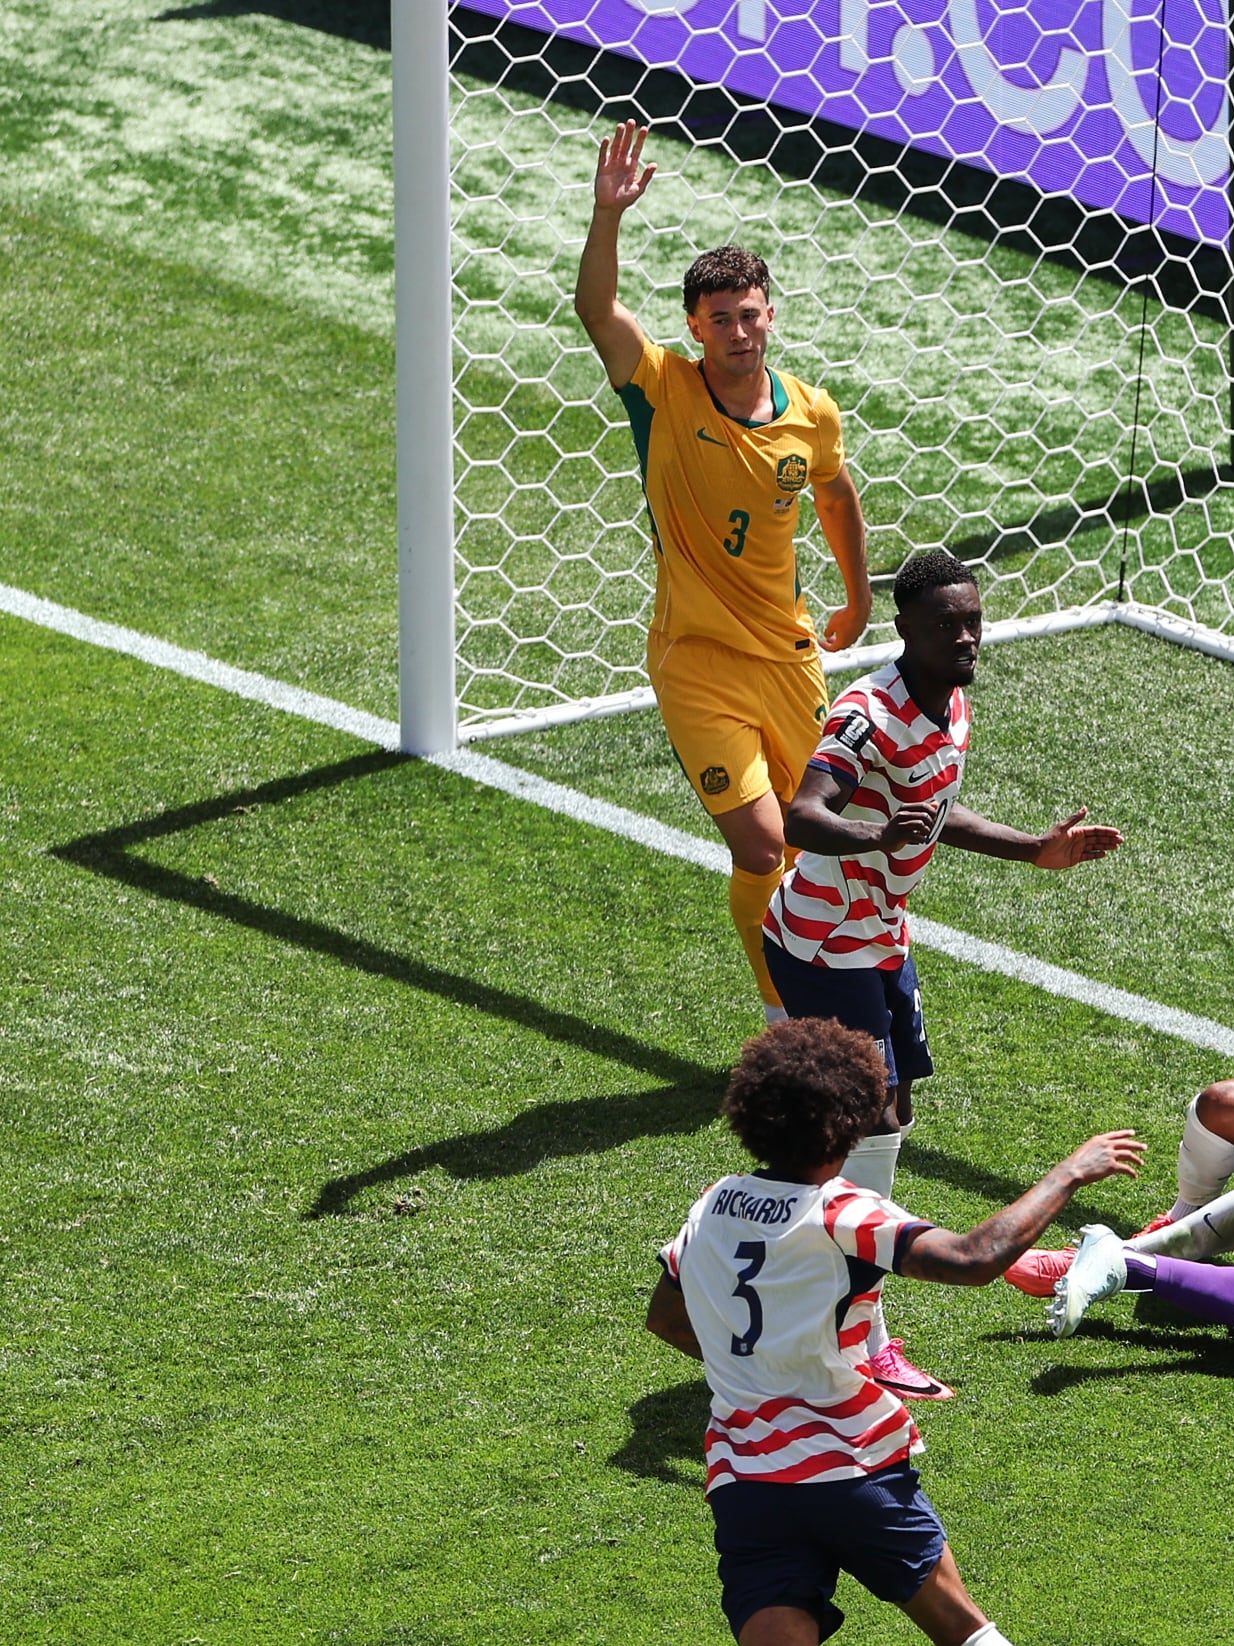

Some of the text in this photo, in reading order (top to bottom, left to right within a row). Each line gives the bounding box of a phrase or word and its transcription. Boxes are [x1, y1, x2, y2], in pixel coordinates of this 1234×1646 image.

[723, 509, 750, 558] 3
[711, 1189, 798, 1224] RICHARDS
[730, 1241, 767, 1357] 3
